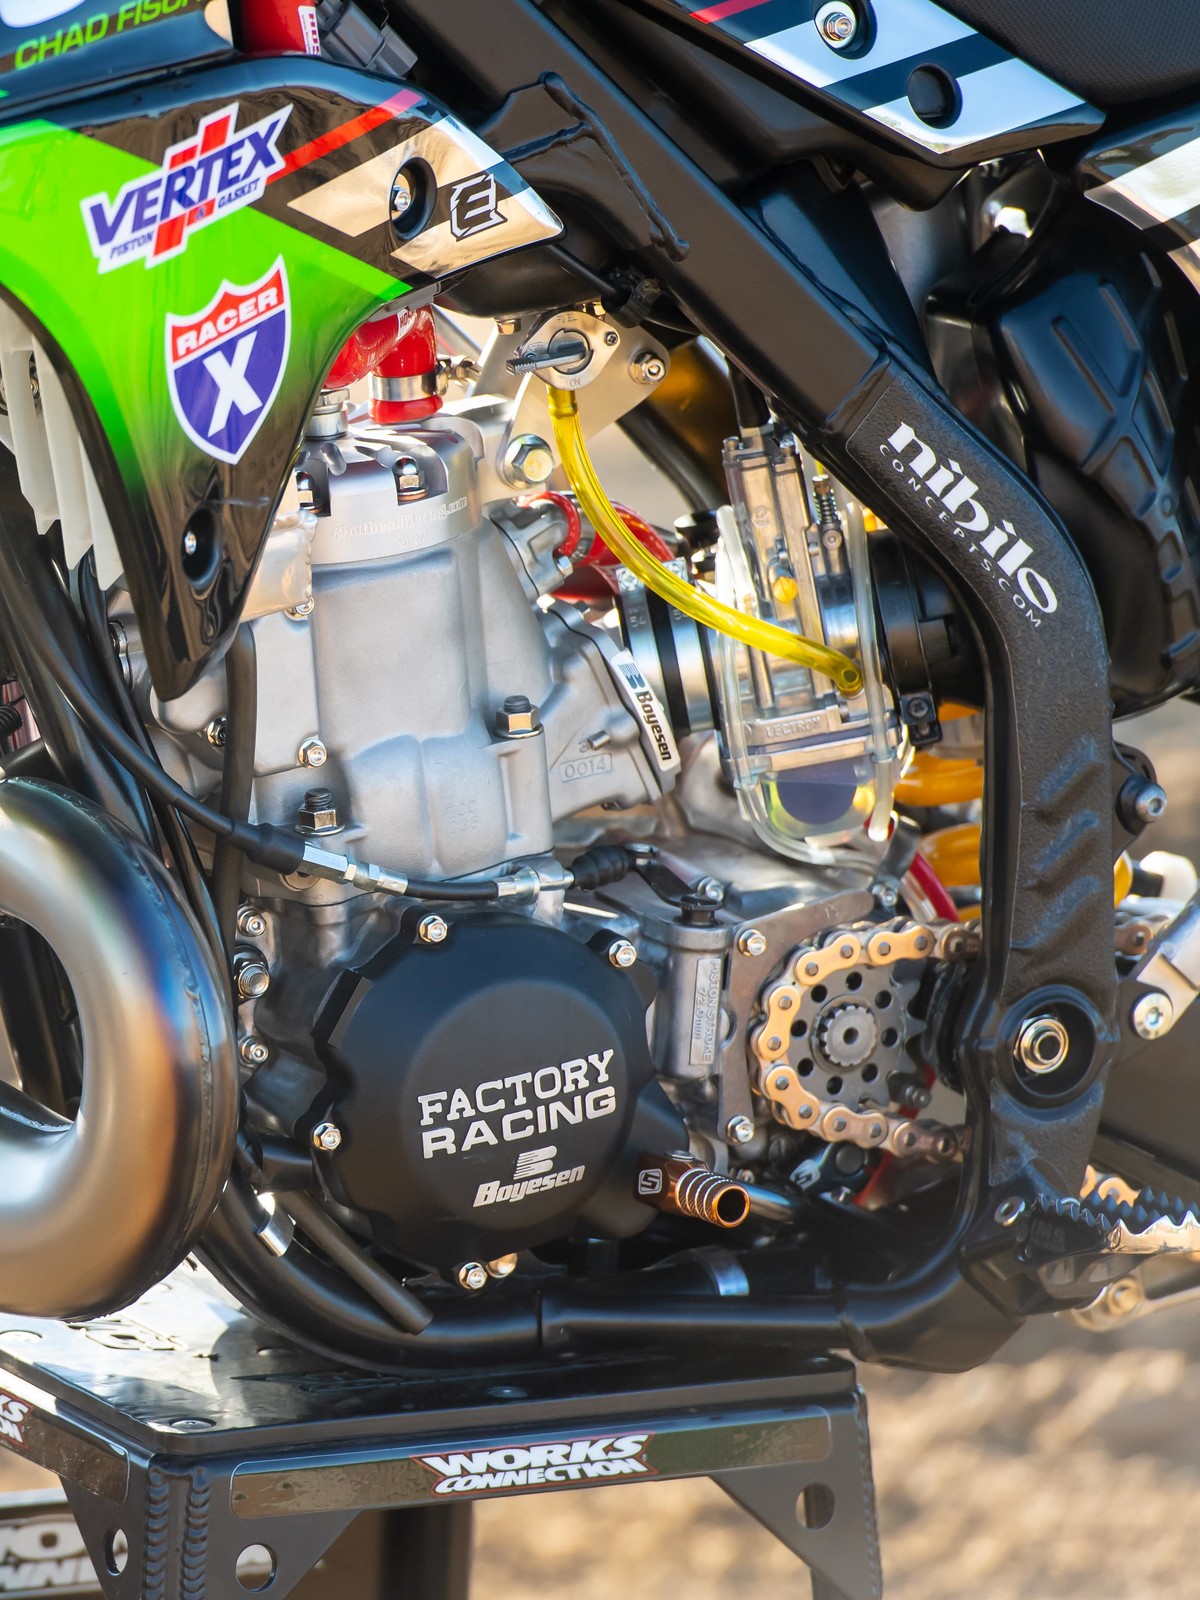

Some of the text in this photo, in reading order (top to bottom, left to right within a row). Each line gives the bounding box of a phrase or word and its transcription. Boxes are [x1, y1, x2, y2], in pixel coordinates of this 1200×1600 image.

[14, 0, 191, 70] CHAD FISC
[90, 118, 281, 246] VERTEX
[110, 231, 154, 260] PISTON
[218, 178, 260, 208] GASKET
[176, 286, 278, 357] RACER
[202, 330, 263, 438] X
[879, 444, 1041, 628] CONCEPTS.COM
[887, 421, 1058, 614] nihilo
[635, 690, 672, 761] Boyesen
[564, 758, 607, 779] 0014
[703, 1010, 716, 1062] STROKE
[418, 1049, 614, 1126] FACTORY
[422, 1086, 616, 1159] RACING
[473, 1165, 585, 1208] Boyesen
[421, 1434, 649, 1477] WORKS
[434, 1457, 649, 1494] CONNECTION
